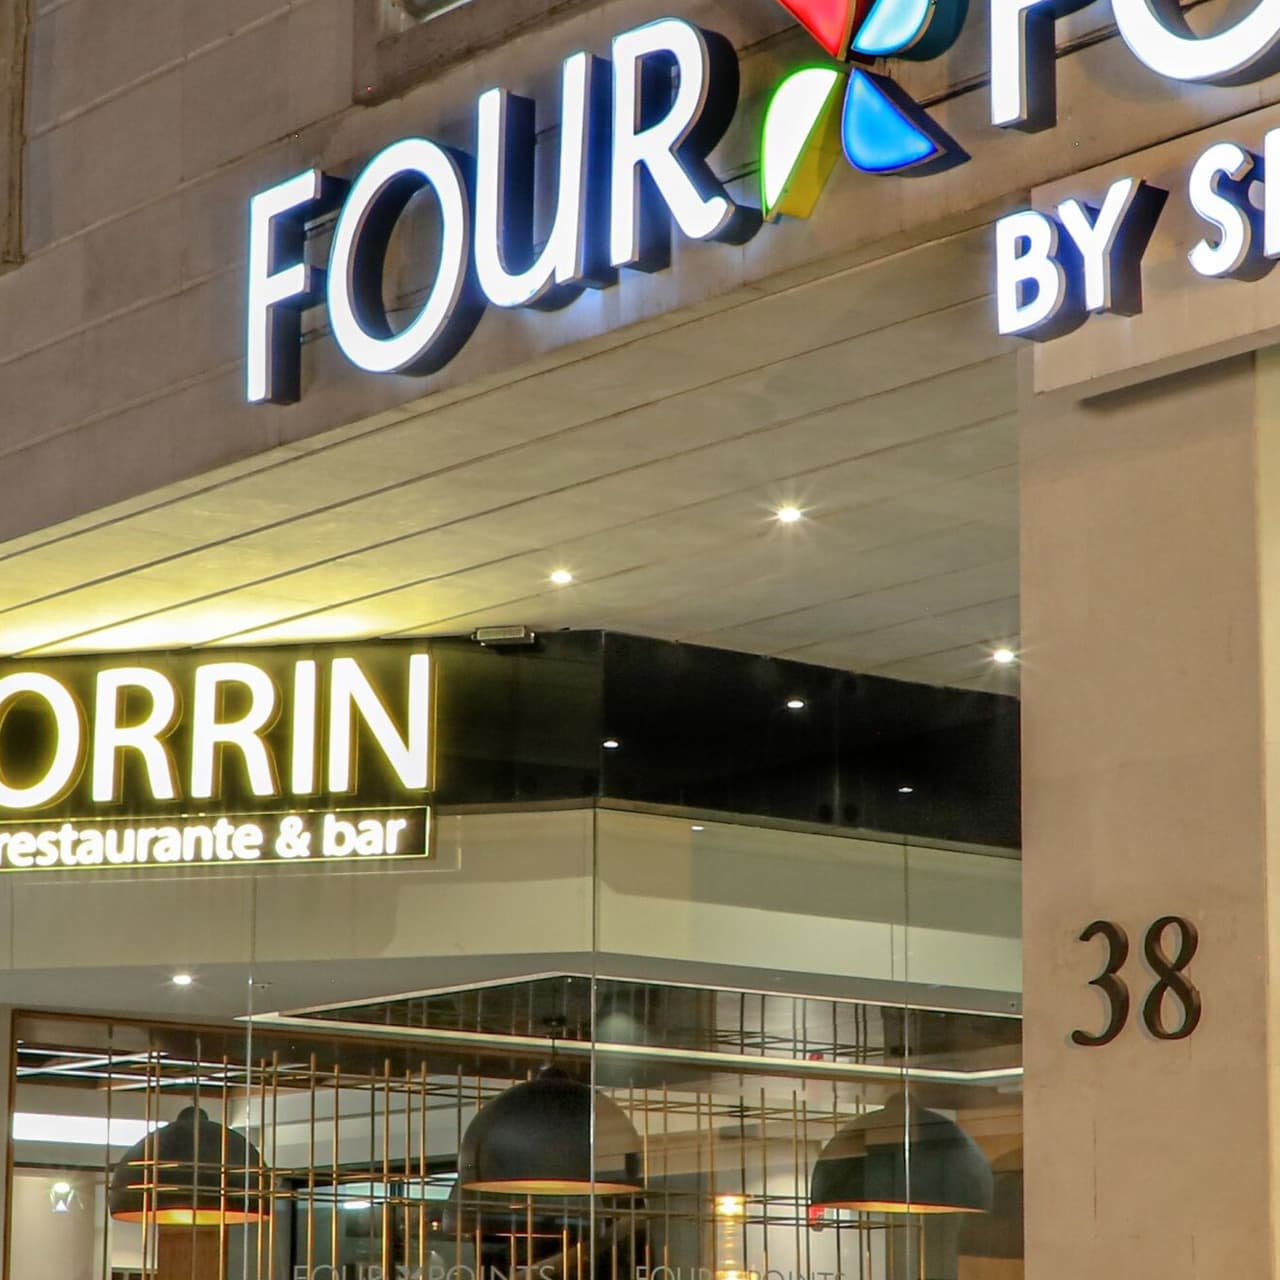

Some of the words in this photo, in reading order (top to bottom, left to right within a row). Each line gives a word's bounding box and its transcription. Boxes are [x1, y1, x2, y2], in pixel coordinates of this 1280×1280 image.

[246, 17, 750, 405] FOUR
[995, 176, 1155, 338] BY
[274, 815, 311, 859] &
[323, 813, 407, 858] bar
[1071, 915, 1202, 1047] 38
